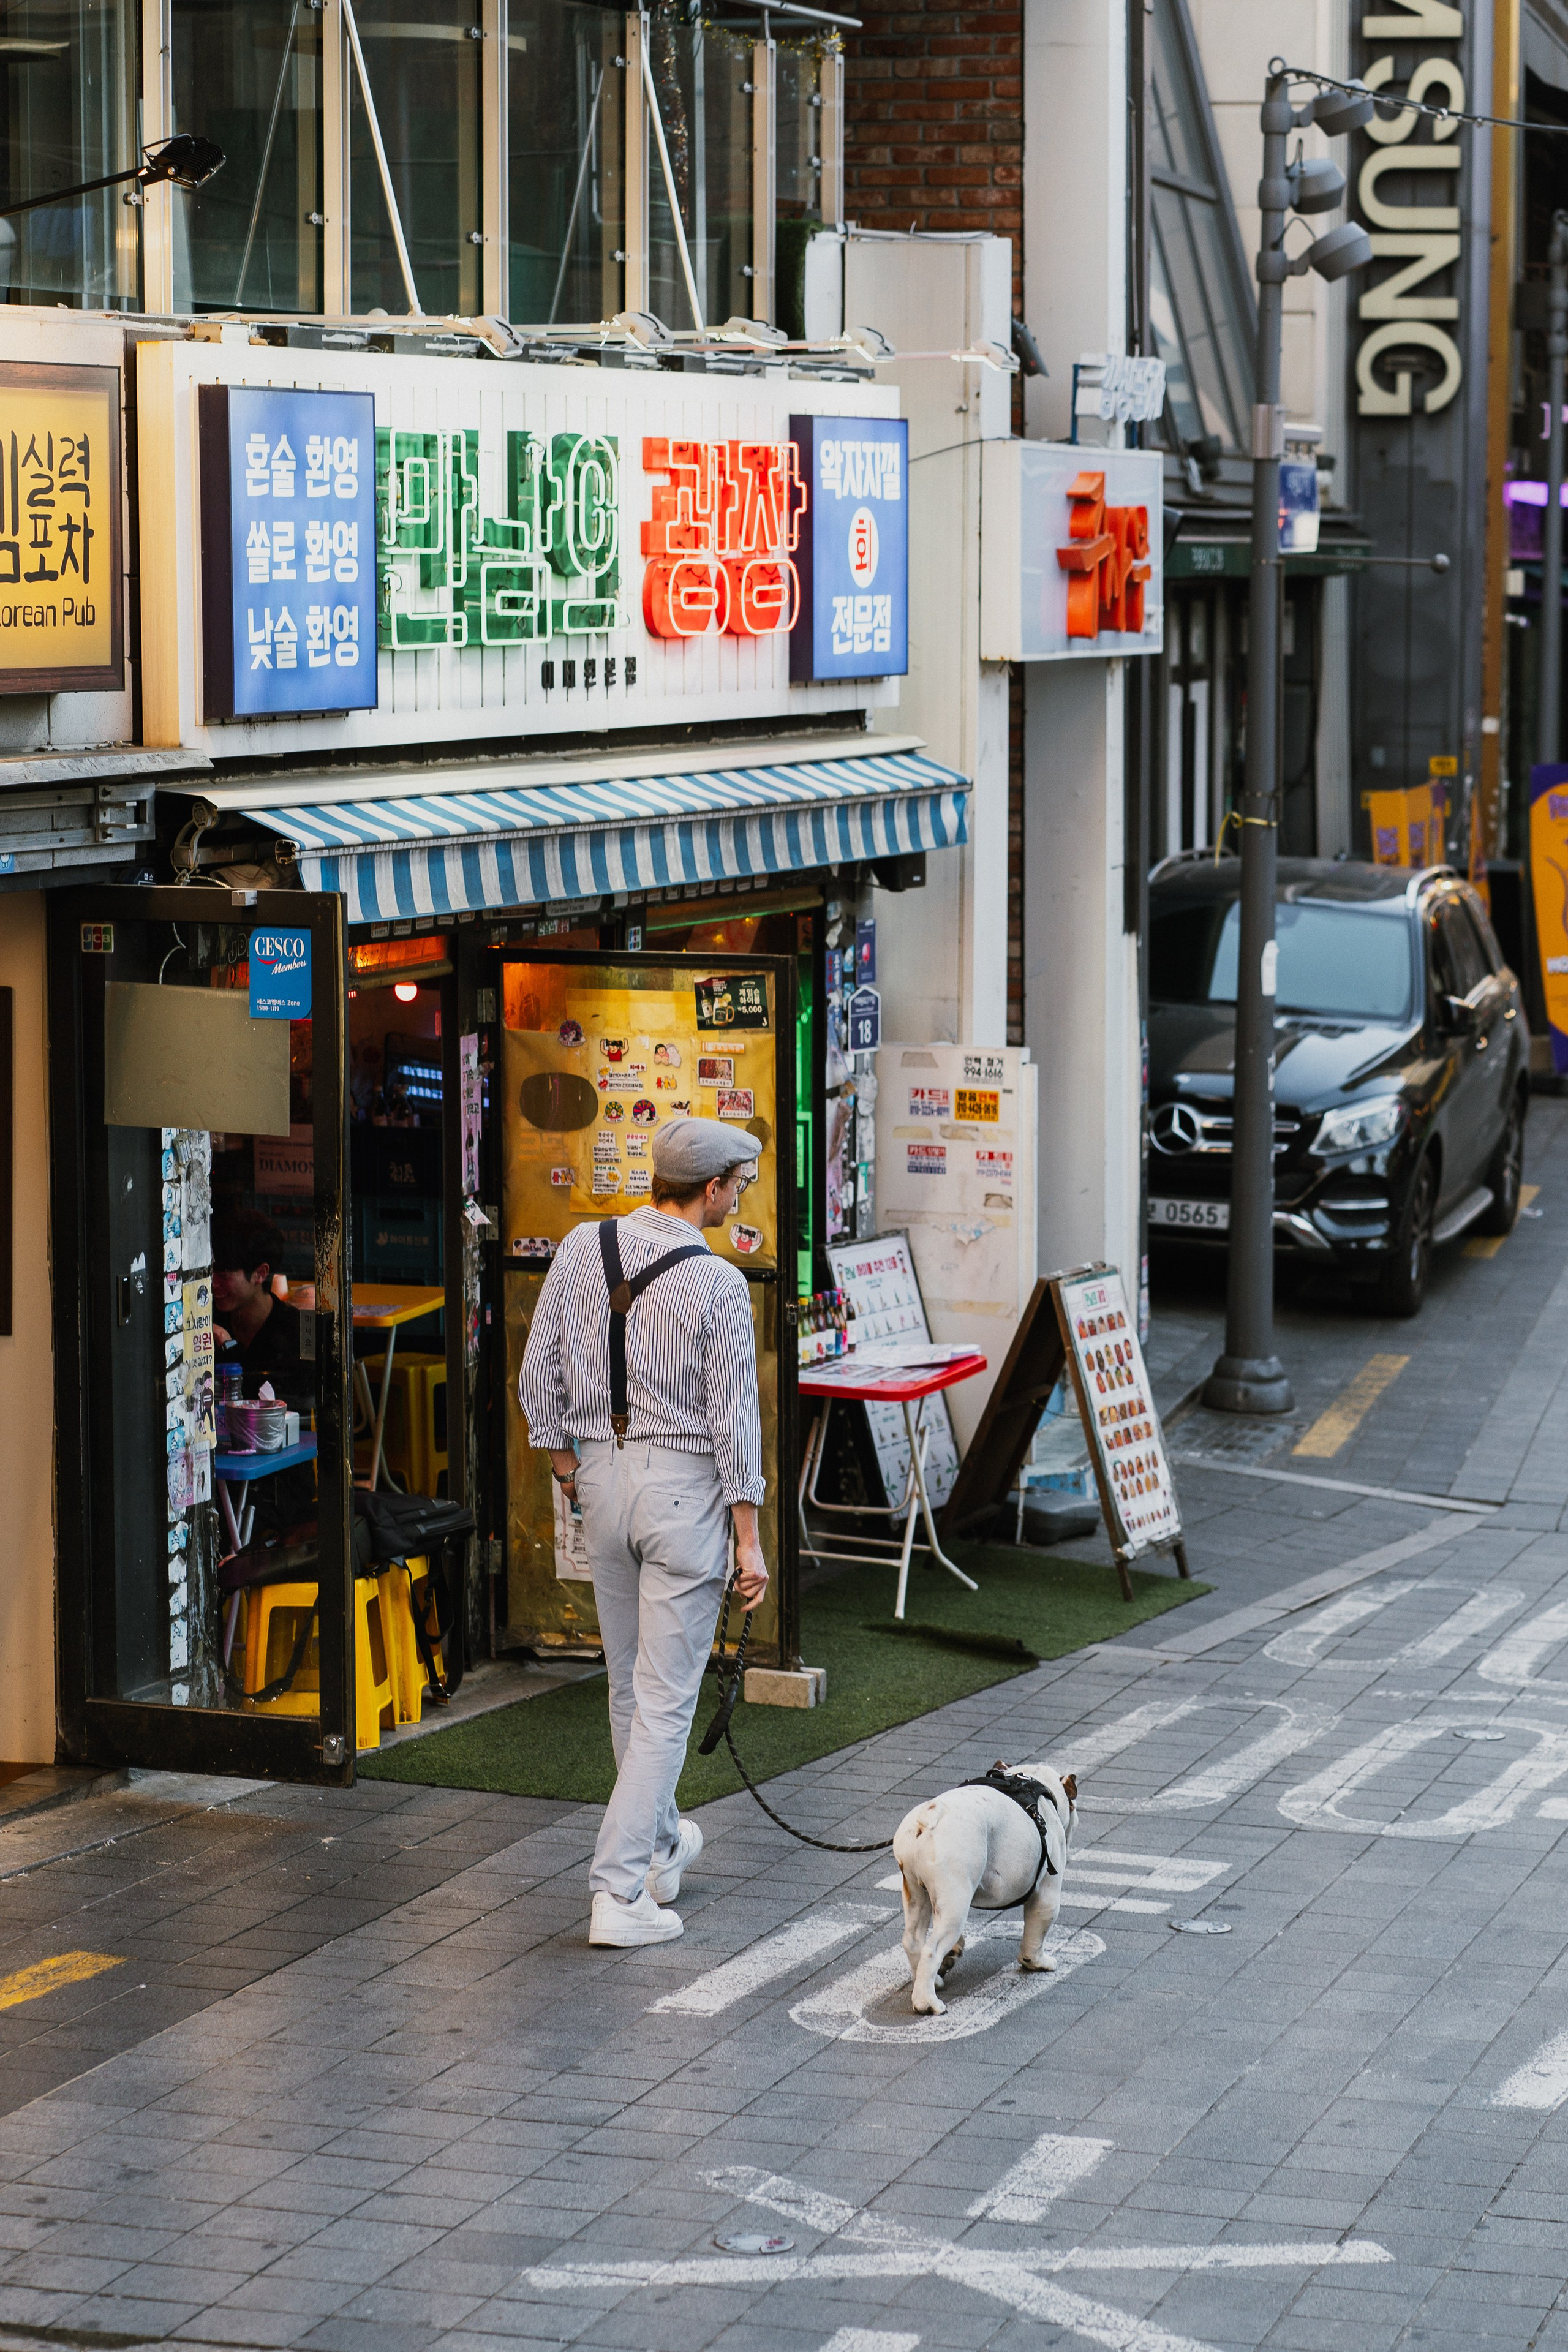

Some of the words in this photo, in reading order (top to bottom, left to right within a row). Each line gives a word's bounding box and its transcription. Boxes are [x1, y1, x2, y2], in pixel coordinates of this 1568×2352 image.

[1355, 0, 1466, 418] SUNG
[21, 430, 90, 508] 실력
[245, 432, 297, 498] 혼술
[305, 435, 359, 499] 환영
[820, 439, 901, 500] 왁자지껄
[23, 512, 94, 584] 포차
[246, 520, 296, 584] 쏠로
[305, 520, 360, 584] 환영
[639, 437, 807, 639] 광장
[855, 518, 872, 573] 회
[0, 603, 56, 627] orean
[62, 596, 96, 627] Pub
[247, 605, 298, 671] 낮술
[306, 605, 360, 668] 환영
[831, 594, 892, 655] 전문점
[82, 933, 110, 944] JCB
[254, 936, 304, 958] CESCO
[271, 957, 307, 975] Members
[858, 1019, 872, 1044] 18
[1166, 1202, 1218, 1224] 0565
[193, 1332, 213, 1353] 영원
